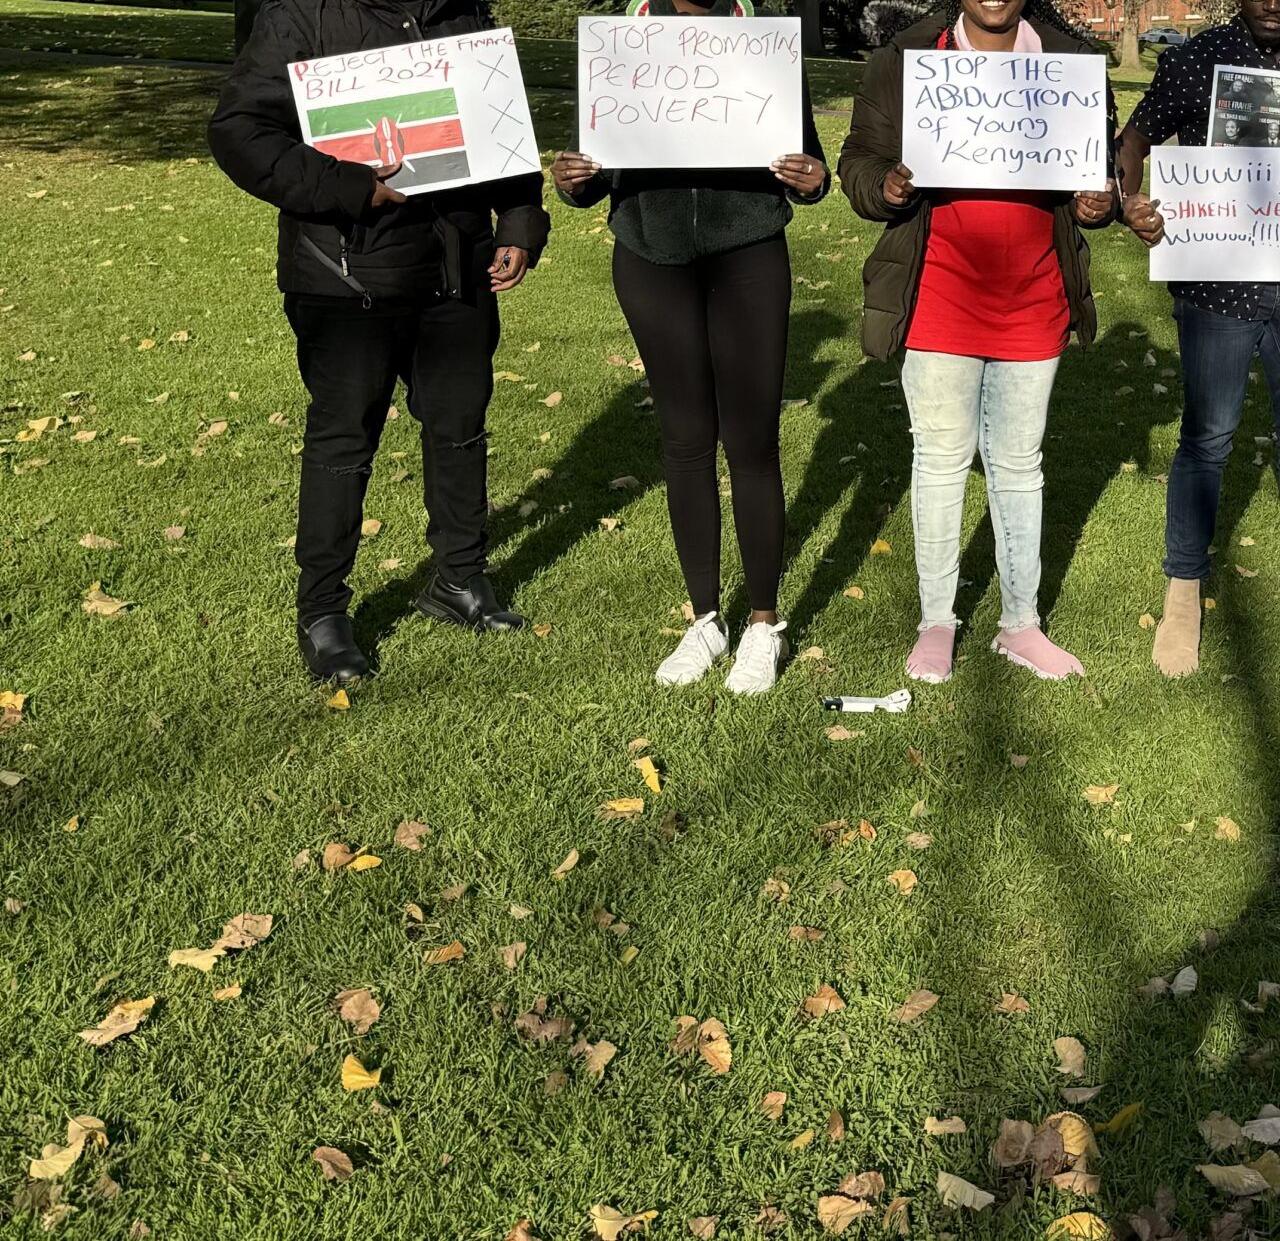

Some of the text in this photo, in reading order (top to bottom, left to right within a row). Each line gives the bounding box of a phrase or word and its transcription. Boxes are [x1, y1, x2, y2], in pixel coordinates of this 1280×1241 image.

[581, 20, 664, 55] STOP
[294, 49, 393, 81] REJECT
[400, 42, 448, 61] THE
[589, 57, 719, 92] PERIOD
[915, 54, 1064, 82] STOP THE
[306, 59, 455, 100] BILL 2024
[590, 91, 773, 131] POVERTY
[915, 83, 1102, 112] ABDUCTIONS
[917, 115, 1049, 143] of Young
